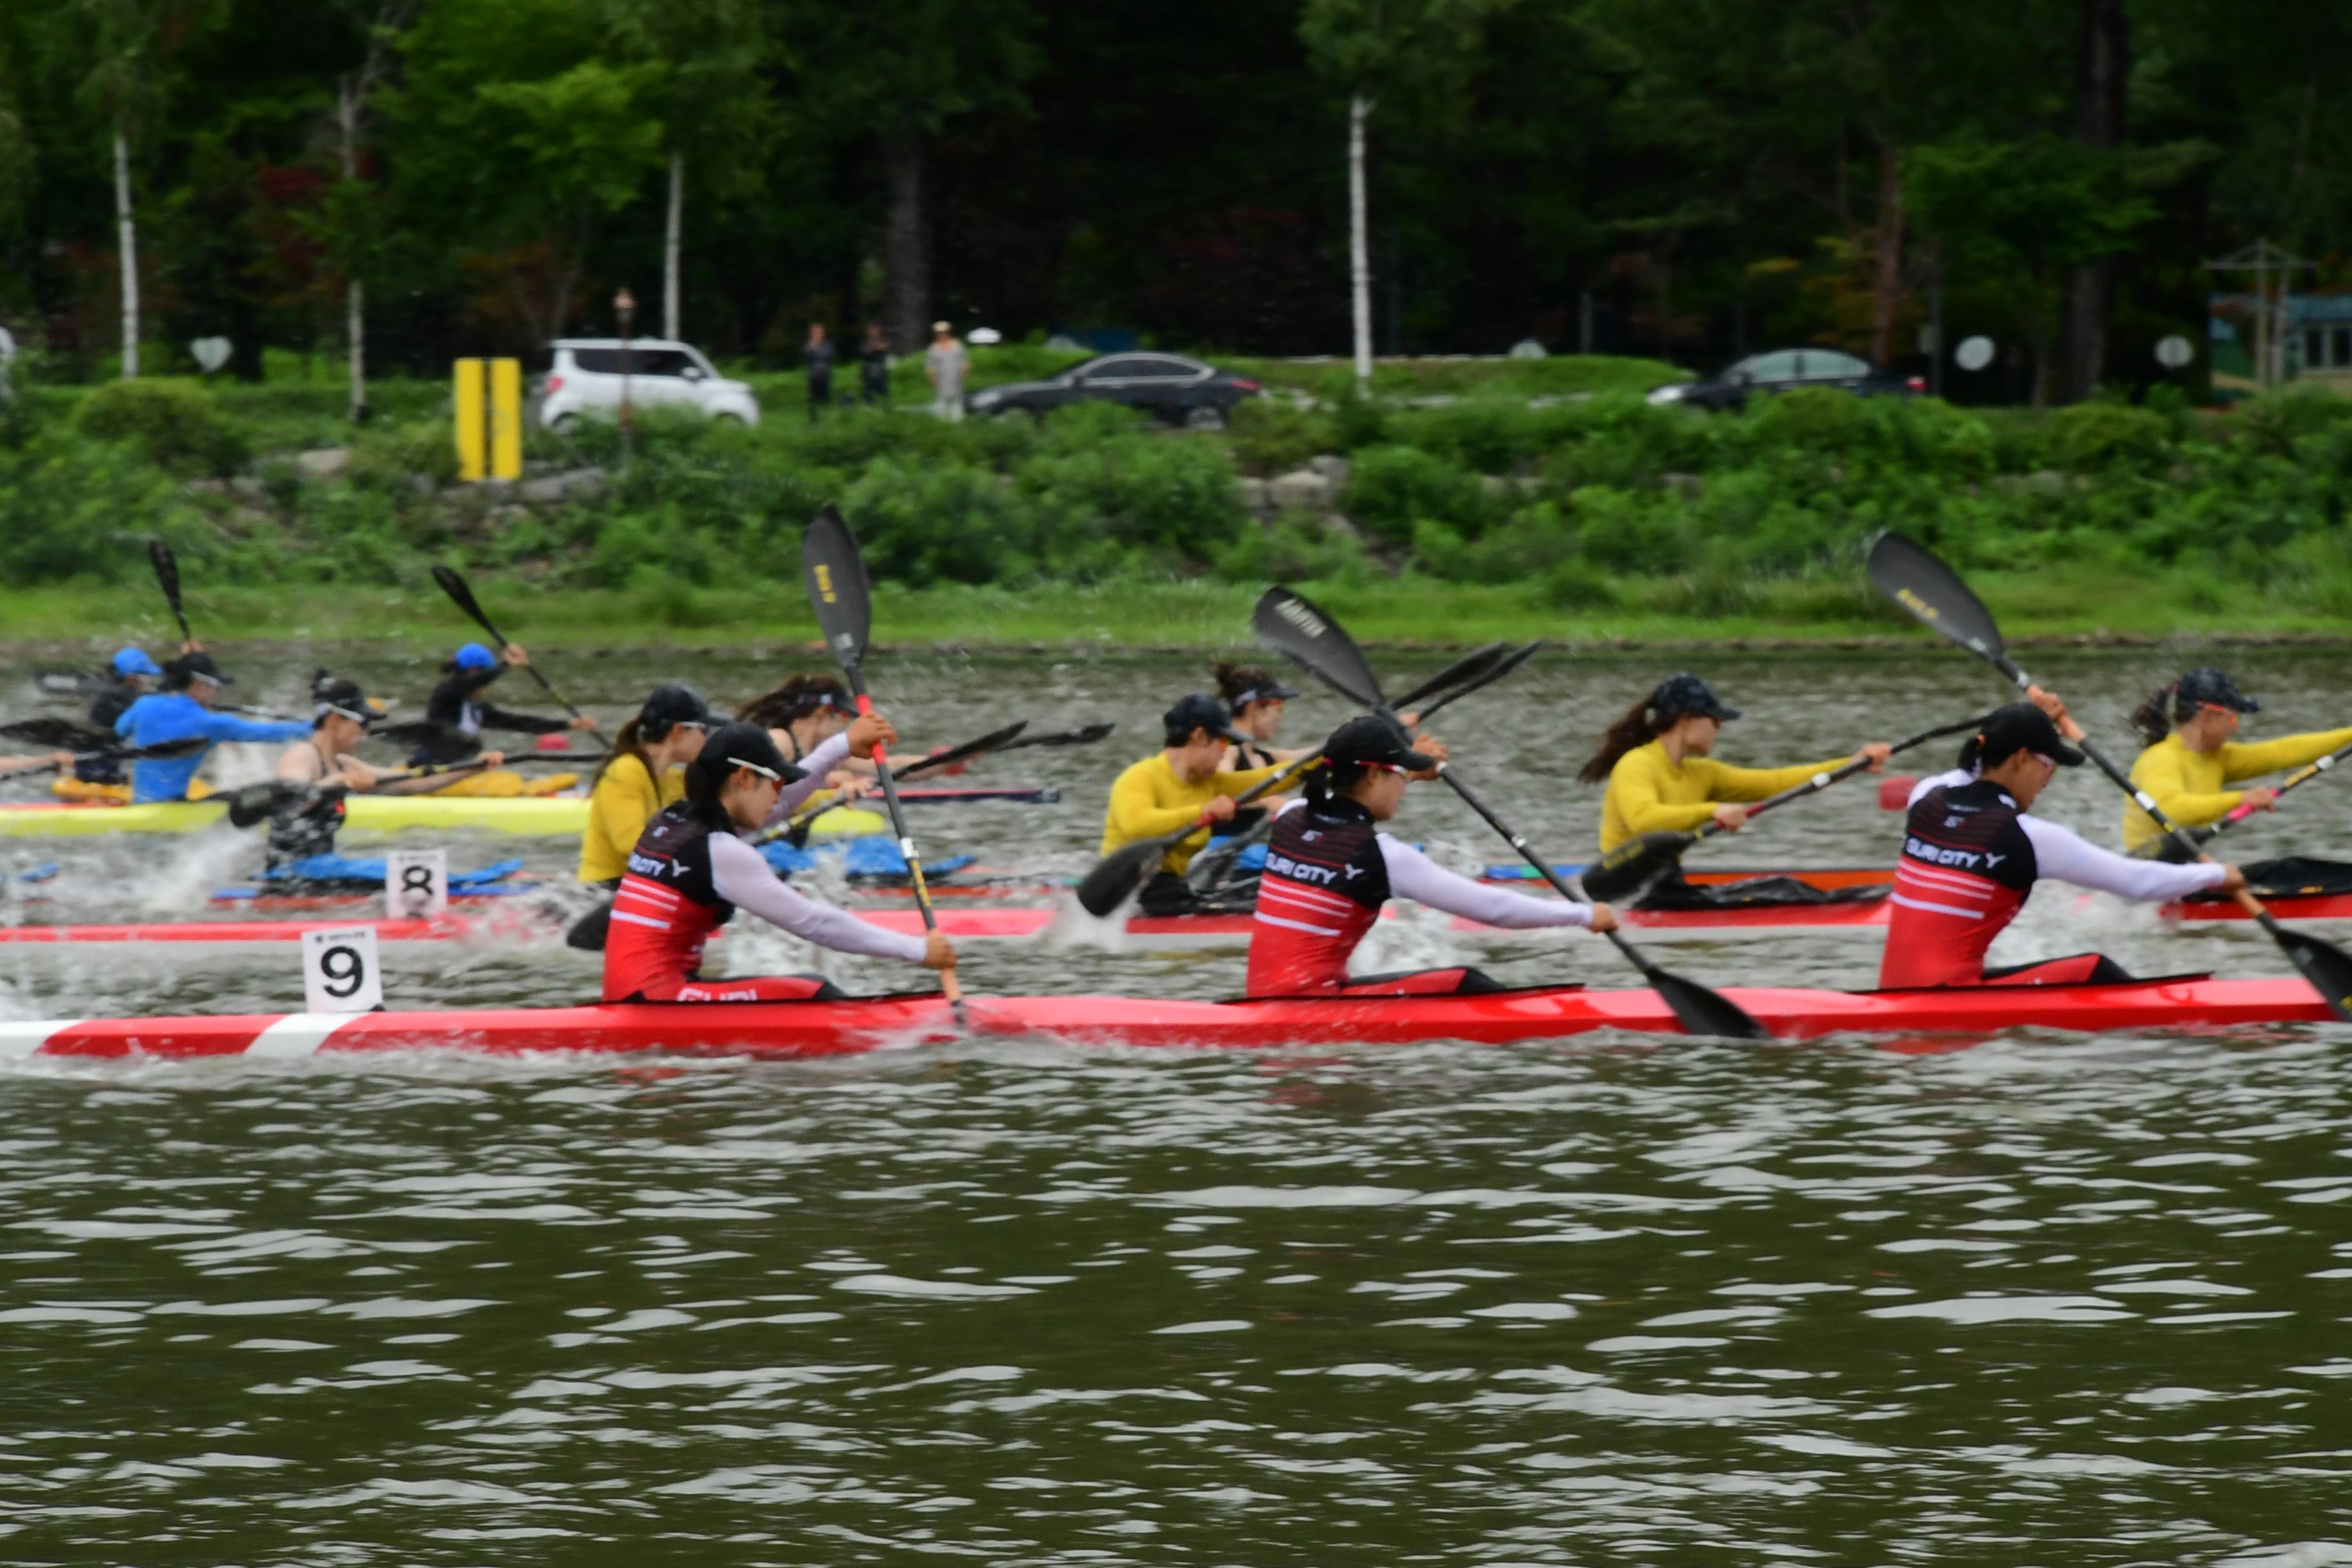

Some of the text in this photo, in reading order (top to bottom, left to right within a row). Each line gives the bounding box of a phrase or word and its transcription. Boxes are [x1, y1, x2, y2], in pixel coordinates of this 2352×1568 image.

[1292, 863, 1338, 885] CITY
[1937, 848, 1981, 869] CITY
[402, 866, 434, 917] 8
[321, 945, 364, 998] 9
